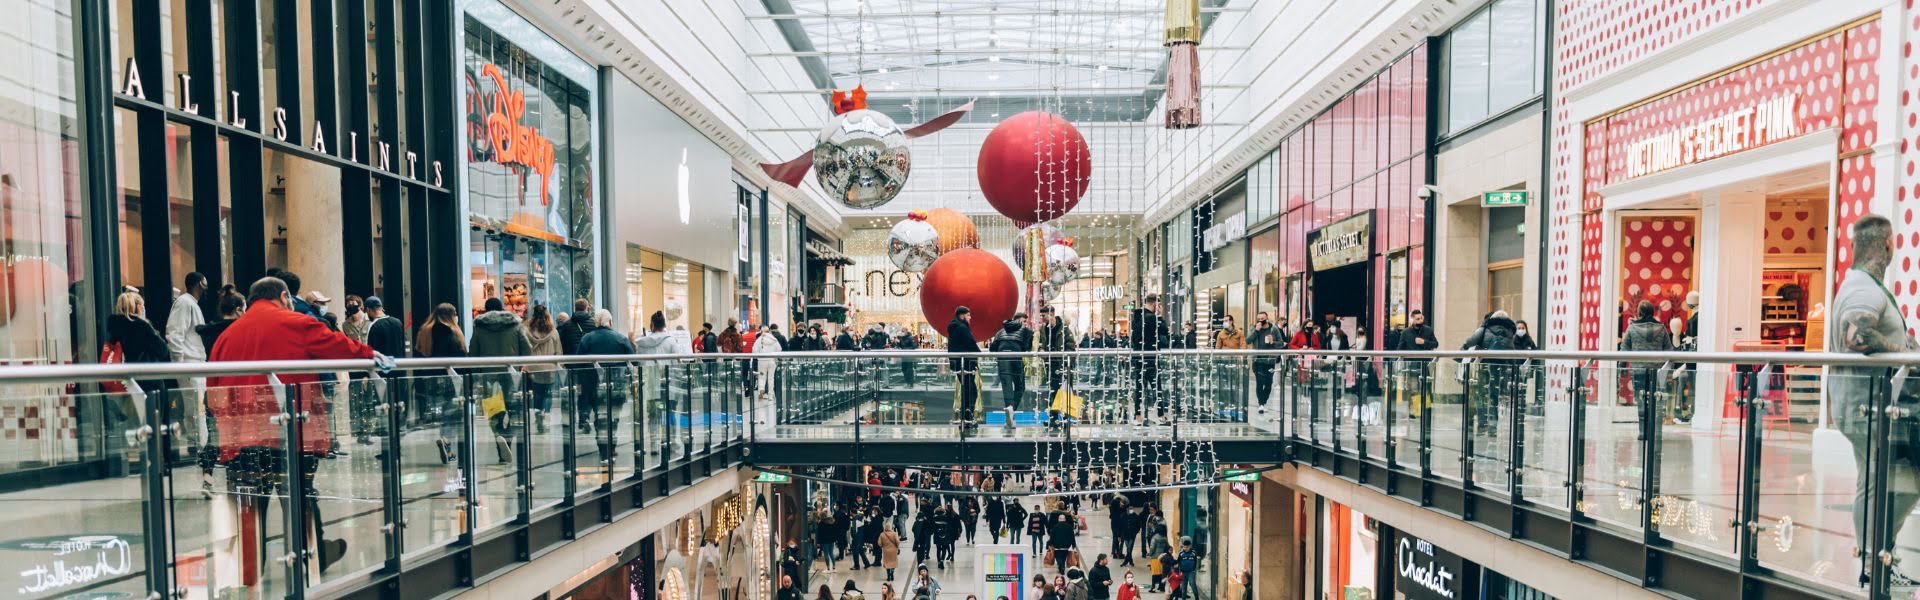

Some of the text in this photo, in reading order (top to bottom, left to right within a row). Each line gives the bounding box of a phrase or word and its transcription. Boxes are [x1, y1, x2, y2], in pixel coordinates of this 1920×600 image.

[1627, 93, 1797, 178] VICTORIA'S SECRET PINK
[1340, 231, 1361, 250] SECRET
[1417, 539, 1433, 557] HOTEL
